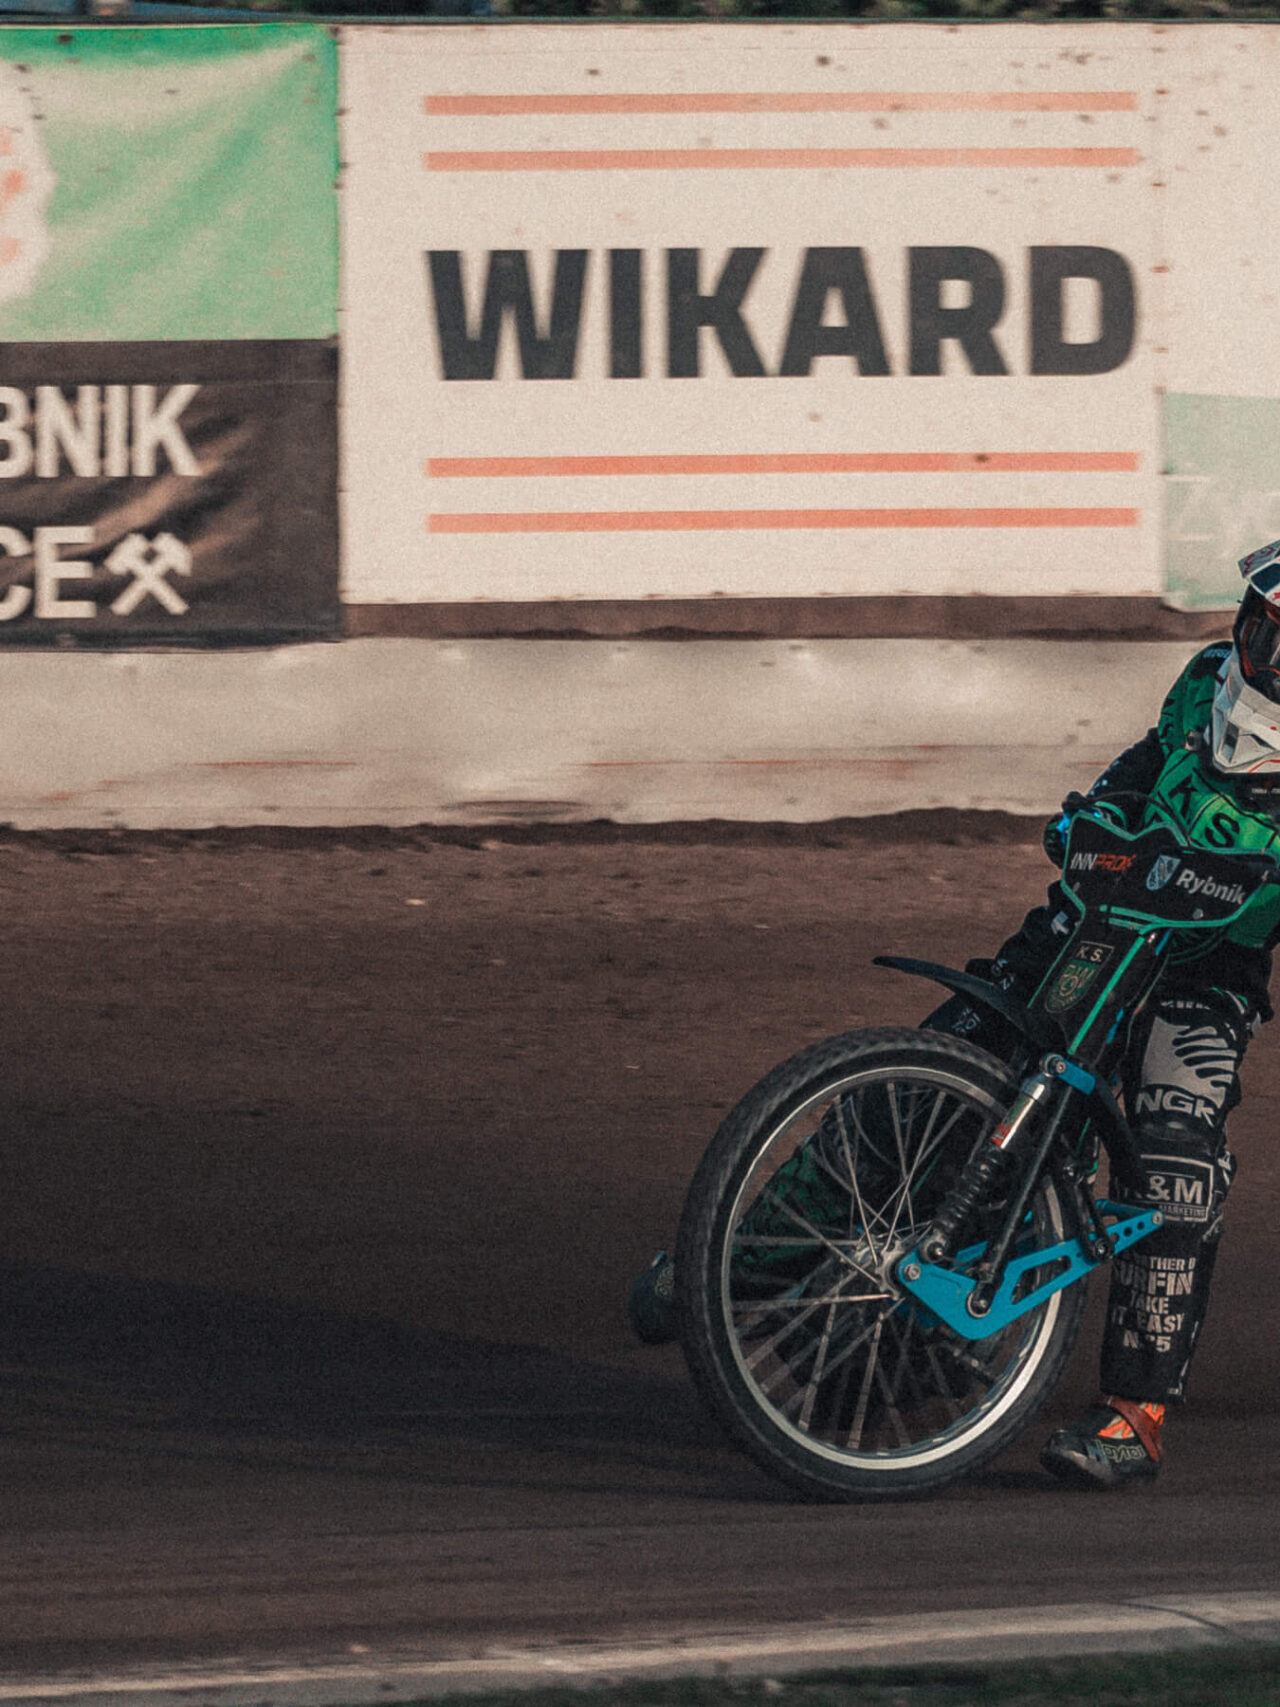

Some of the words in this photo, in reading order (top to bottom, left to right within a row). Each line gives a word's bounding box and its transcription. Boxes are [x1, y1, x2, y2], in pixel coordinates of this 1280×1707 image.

[425, 246, 1140, 380] WIKARD
[1175, 868, 1247, 905] Rybnik
[1135, 1088, 1215, 1127] NGK
